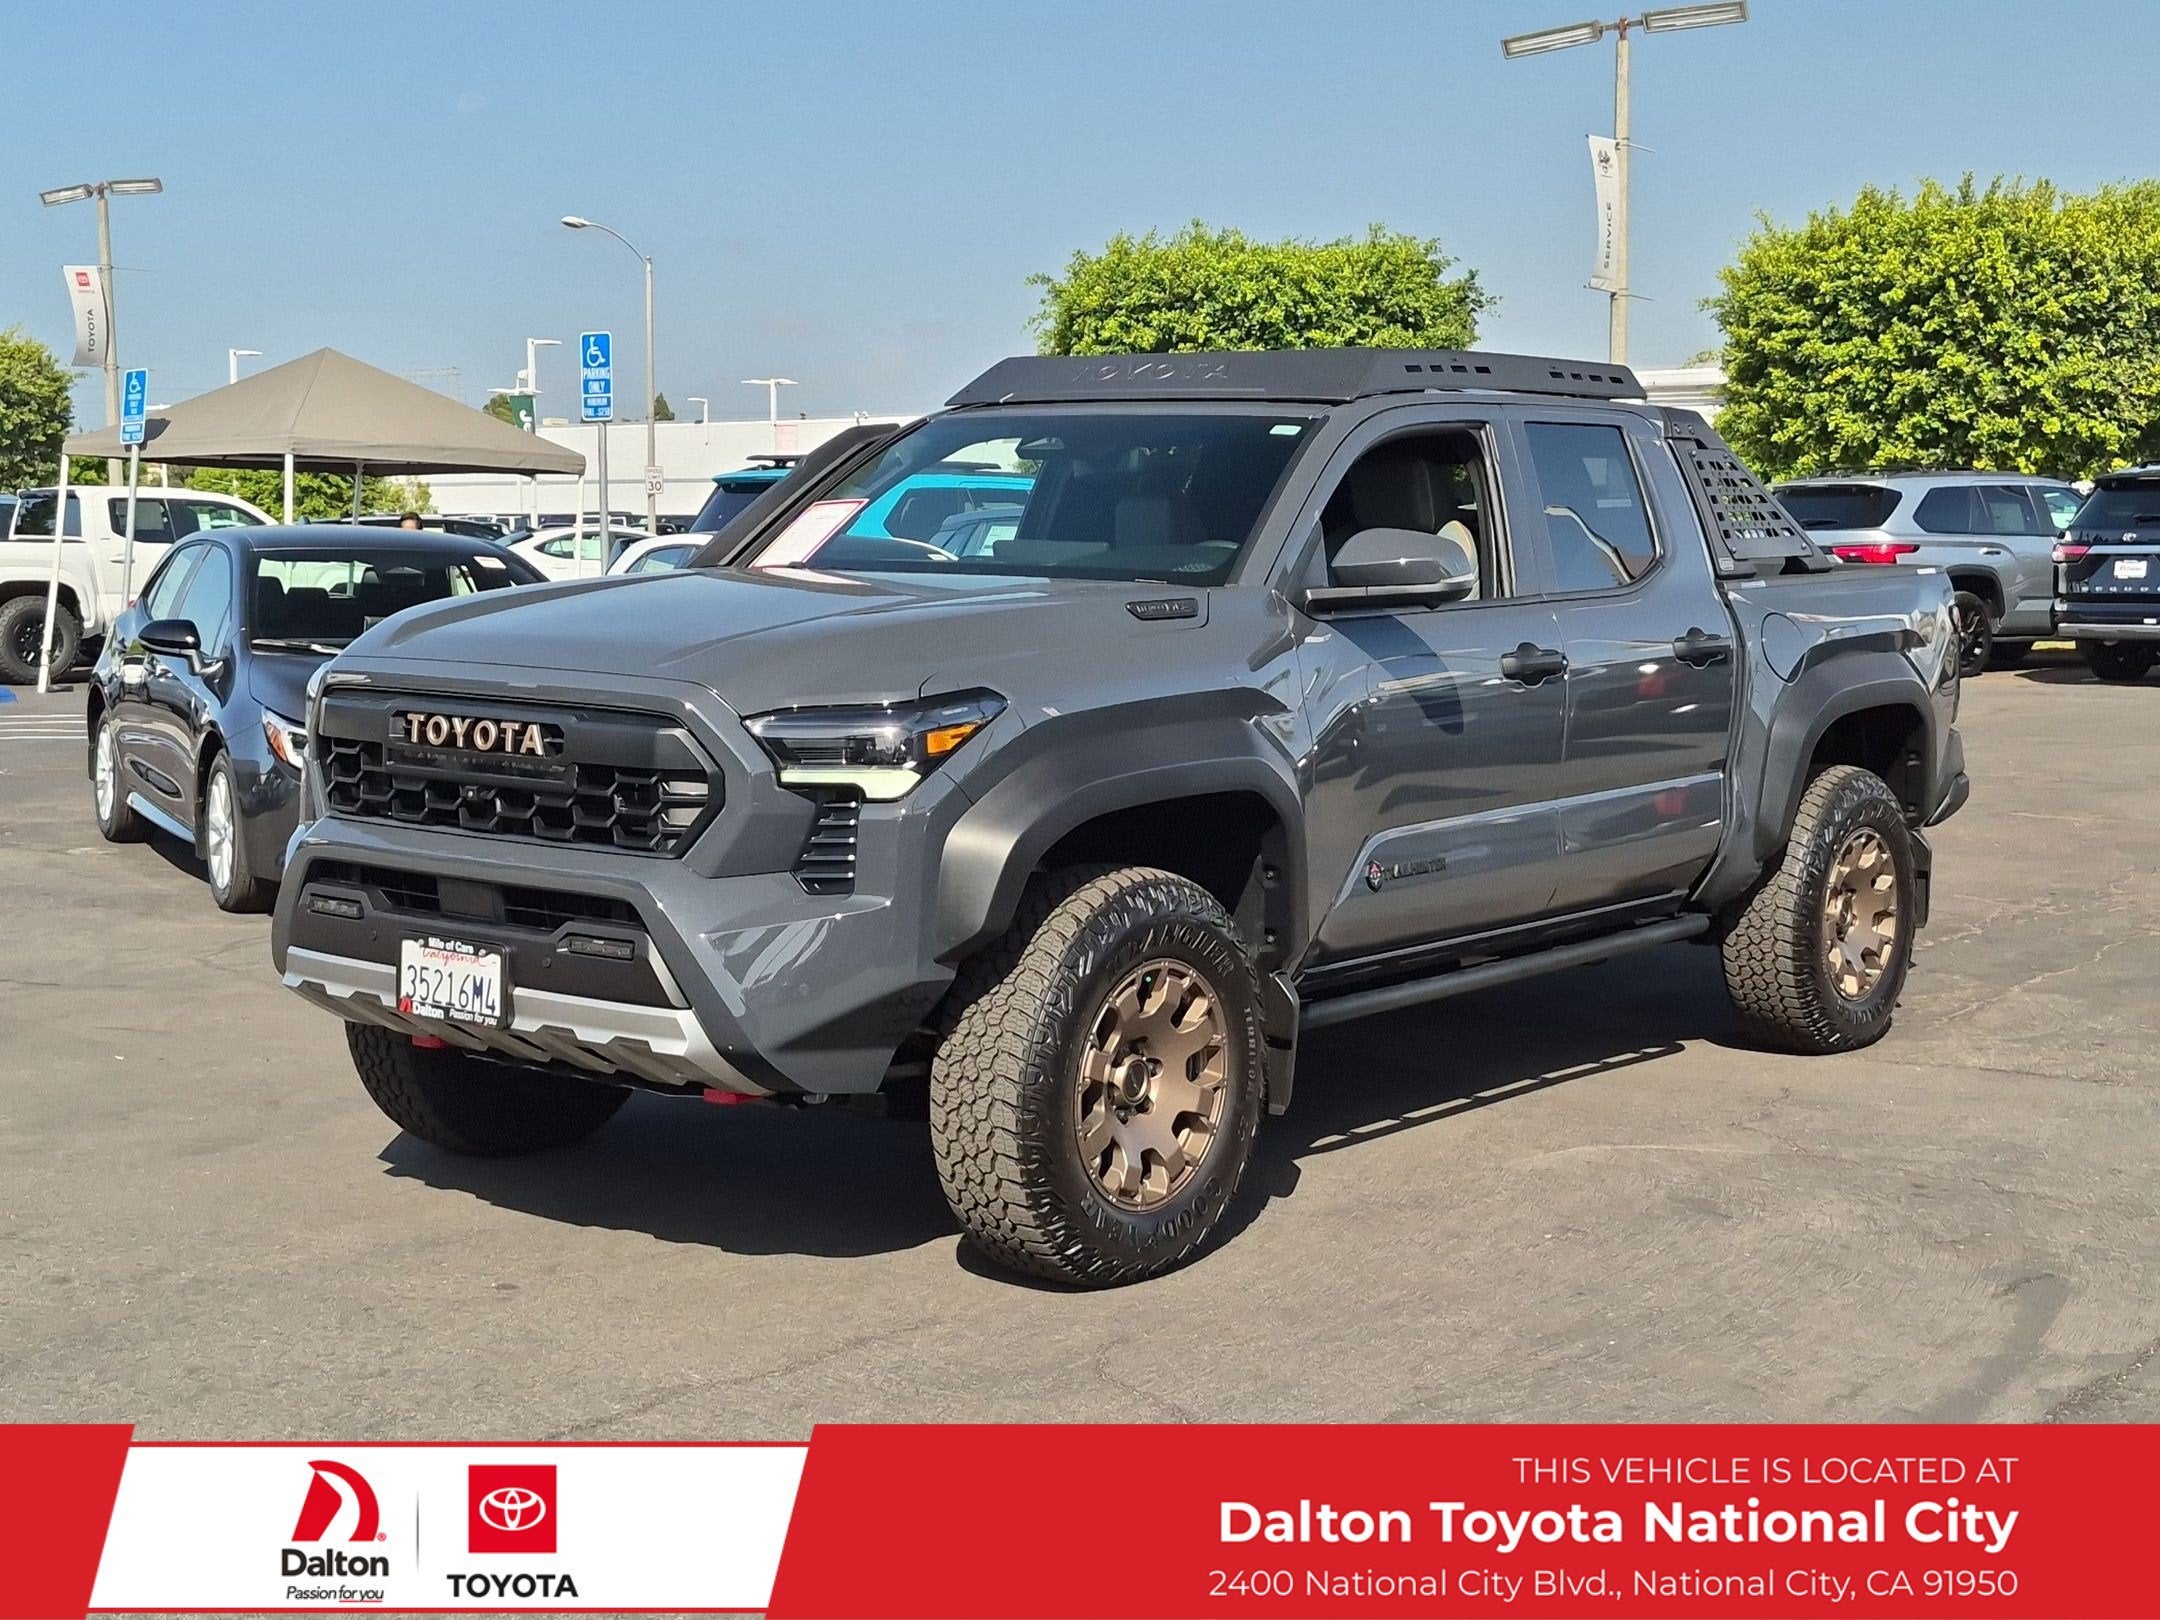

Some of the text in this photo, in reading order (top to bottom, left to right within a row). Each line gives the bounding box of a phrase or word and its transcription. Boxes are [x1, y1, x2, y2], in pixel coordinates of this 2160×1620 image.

[1604, 202, 1612, 269] SERVICE
[87, 308, 96, 353] TOYOTA
[583, 367, 610, 380] PARKING
[588, 380, 606, 393] ONLY
[648, 481, 662, 491] 30
[406, 713, 545, 756] TOYOTA
[428, 937, 475, 954] Mile of Cars
[406, 964, 496, 1015] 35216M4
[412, 1001, 498, 1026] Dalton Passion for you
